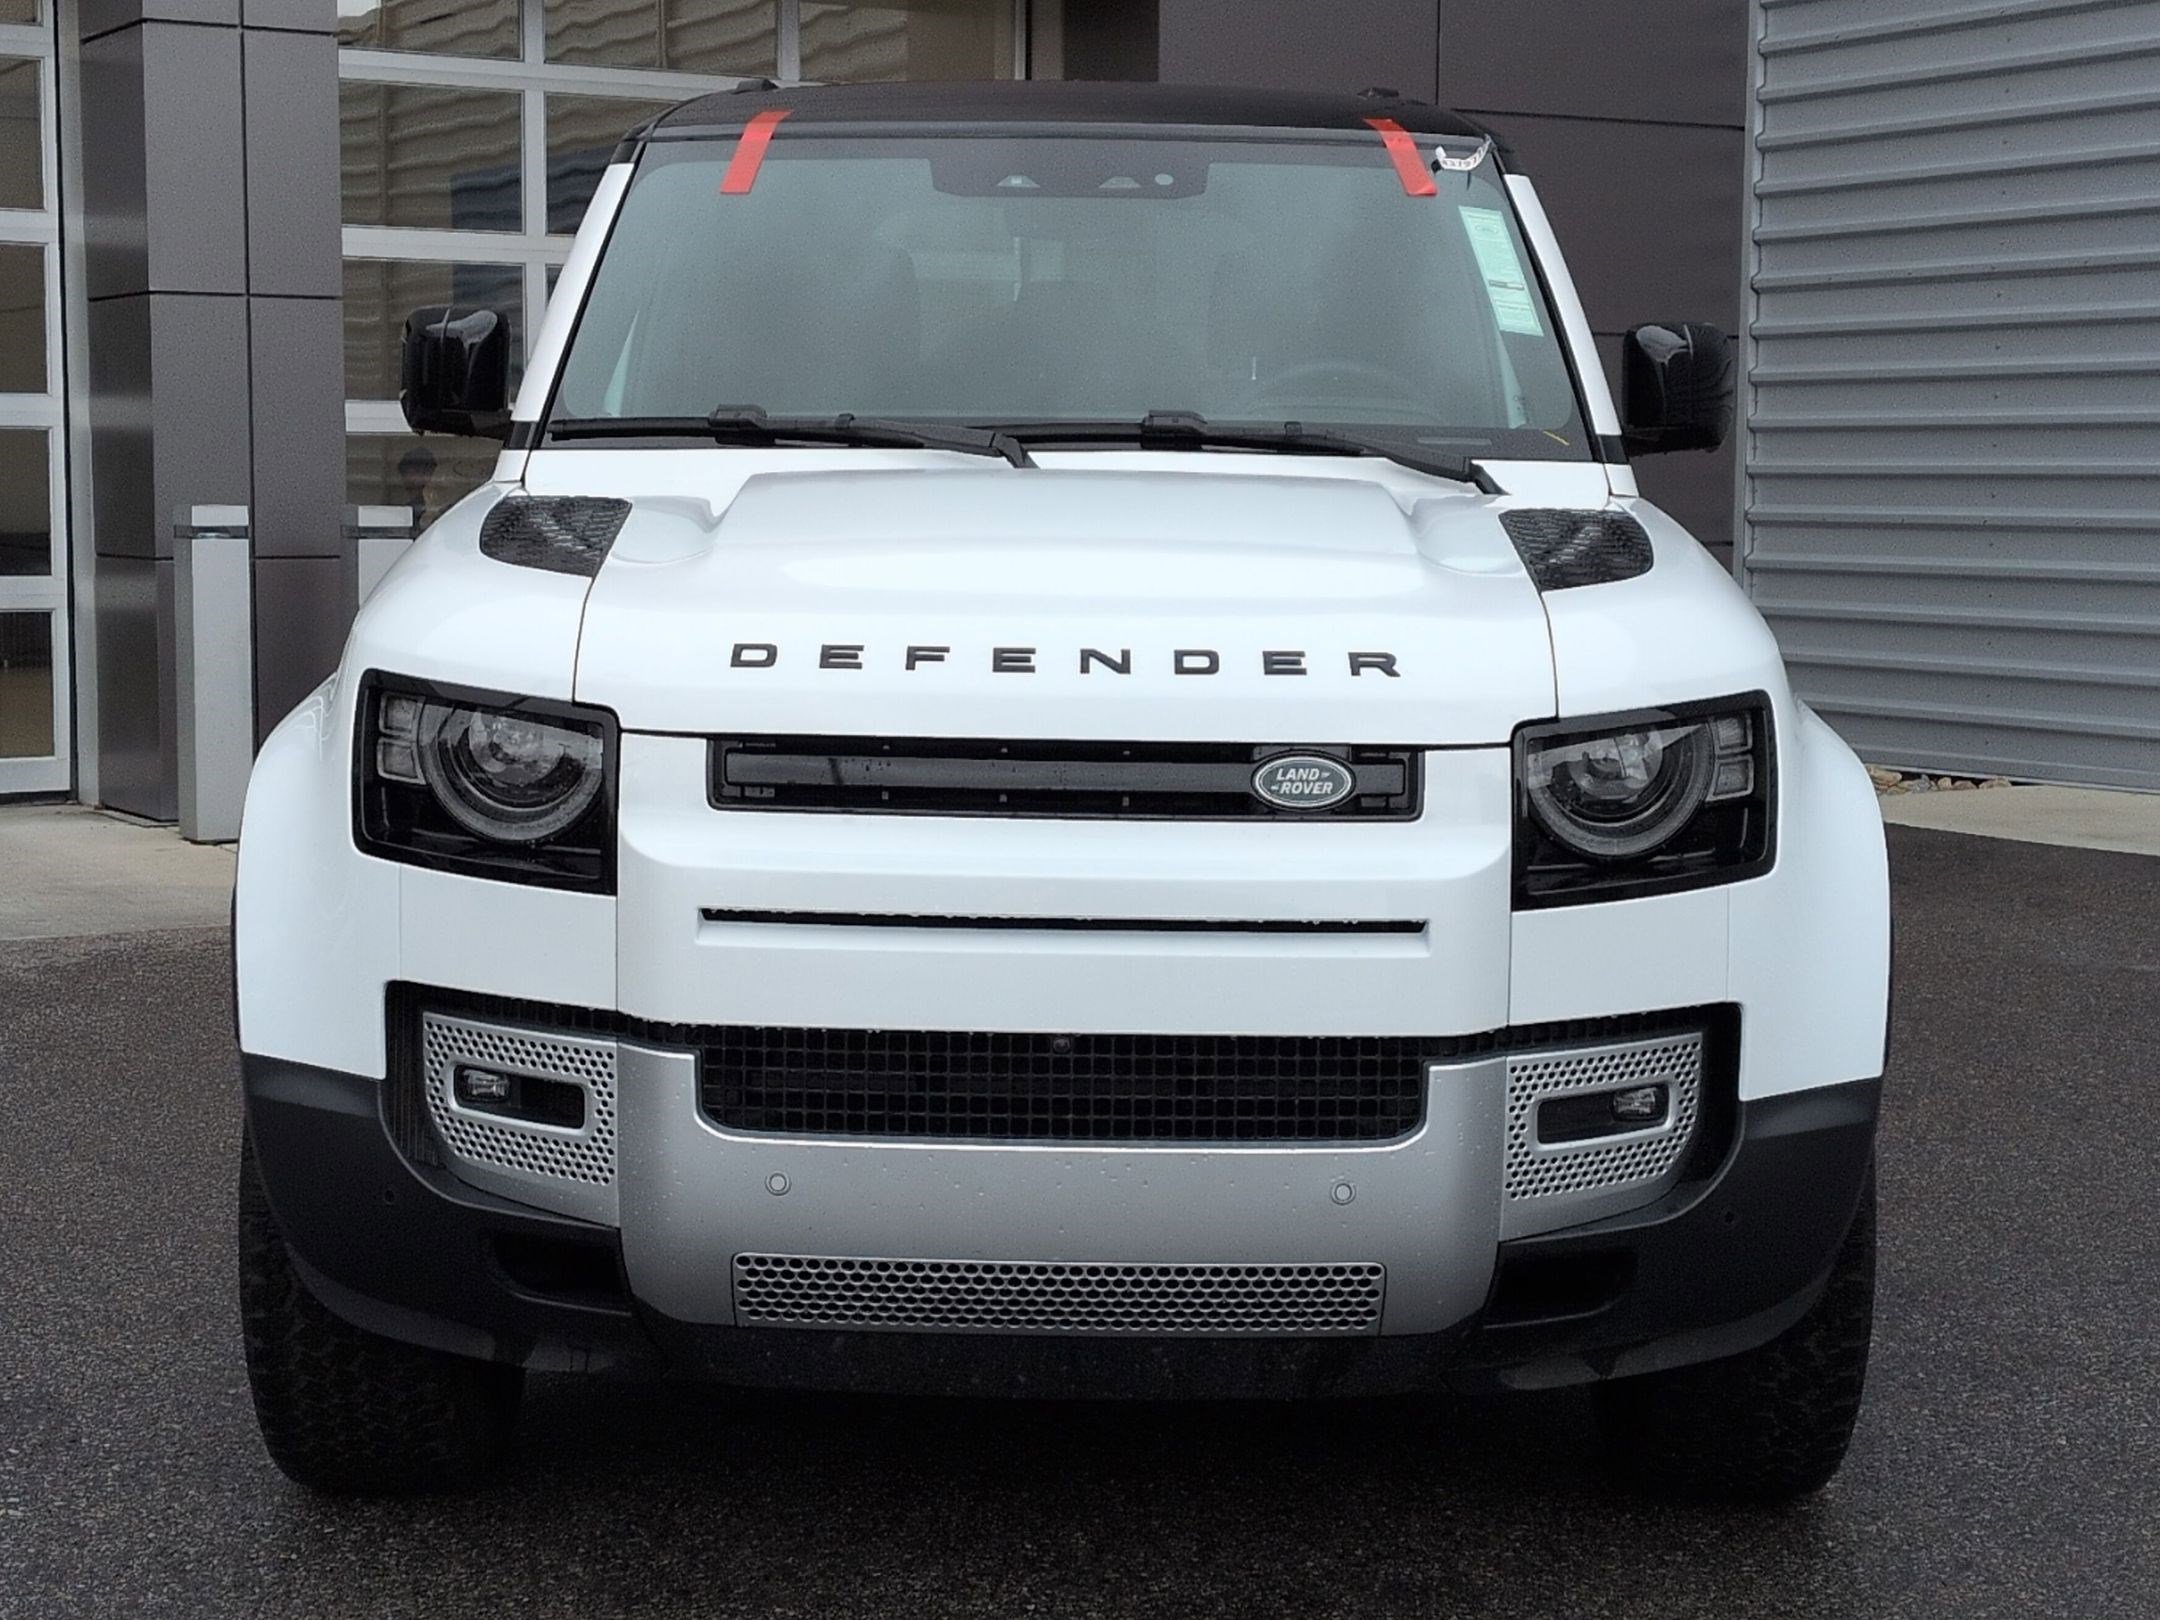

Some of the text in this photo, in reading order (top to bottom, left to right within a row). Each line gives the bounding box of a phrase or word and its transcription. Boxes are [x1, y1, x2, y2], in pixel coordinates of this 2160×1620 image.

[731, 643, 1401, 677] DEFENDER
[1276, 768, 1320, 780] LAND
[1280, 782, 1334, 795] ROVER
